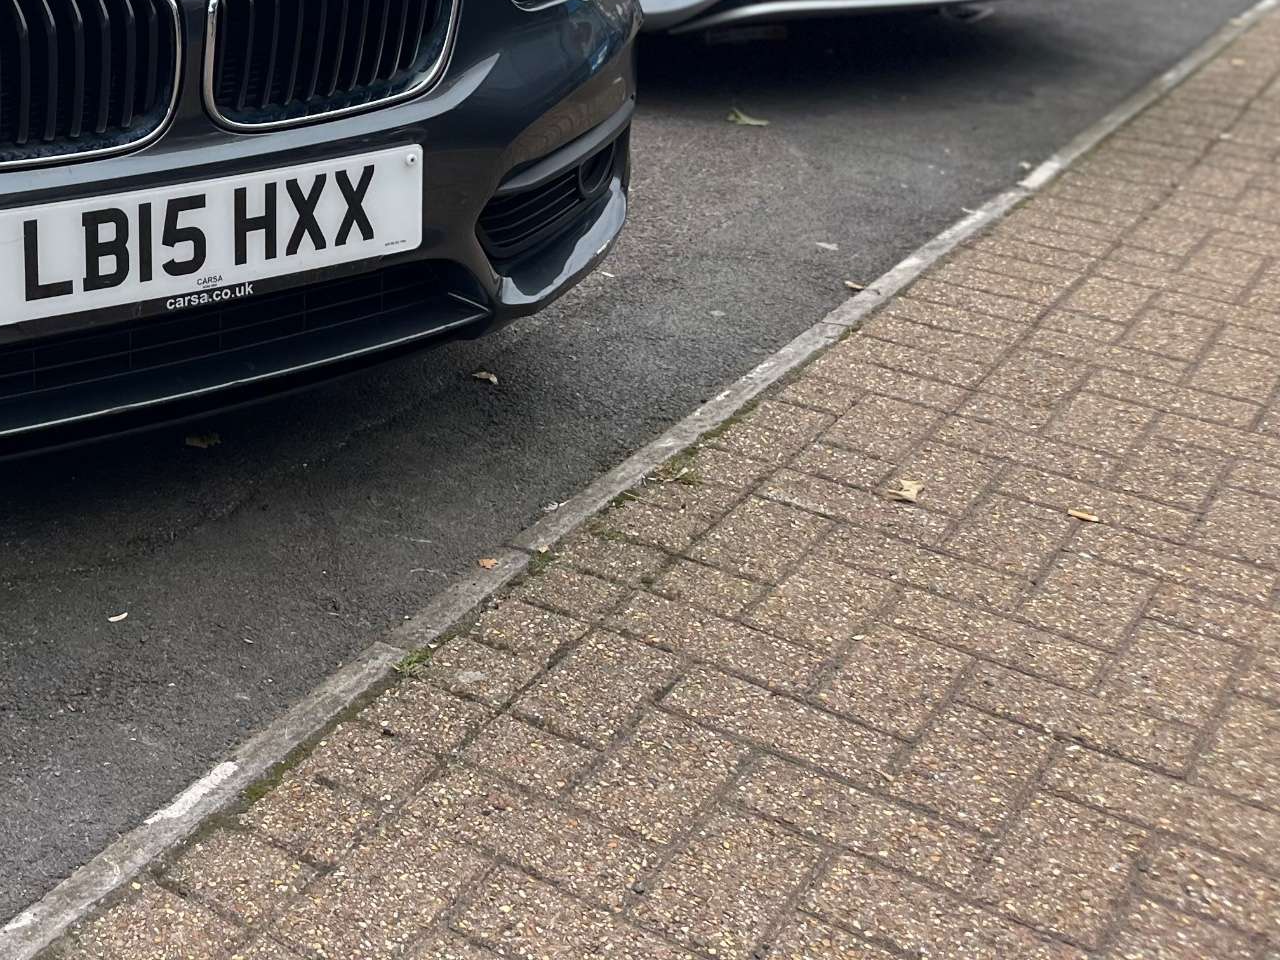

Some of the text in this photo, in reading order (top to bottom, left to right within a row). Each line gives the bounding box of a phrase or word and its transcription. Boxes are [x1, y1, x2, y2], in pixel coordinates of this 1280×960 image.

[23, 164, 376, 303] LB15 HXX
[196, 275, 223, 286] CARSA
[166, 282, 254, 310] carsa.co.uk
